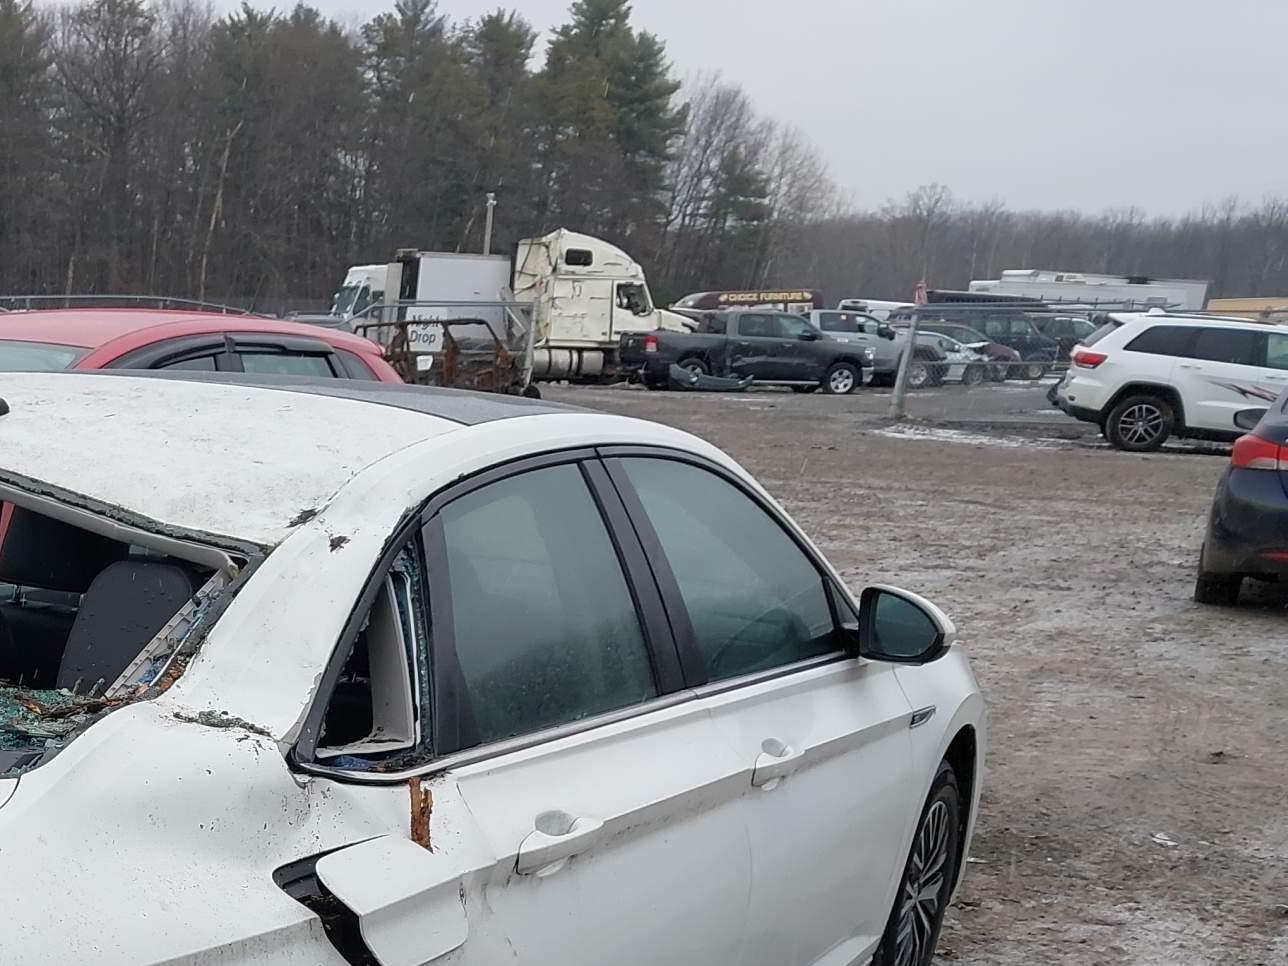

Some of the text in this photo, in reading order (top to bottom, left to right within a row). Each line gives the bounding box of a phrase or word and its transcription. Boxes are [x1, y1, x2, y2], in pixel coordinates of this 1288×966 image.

[759, 291, 803, 301] FURNITURE
[412, 314, 440, 330] Night
[410, 330, 436, 345] Drop
